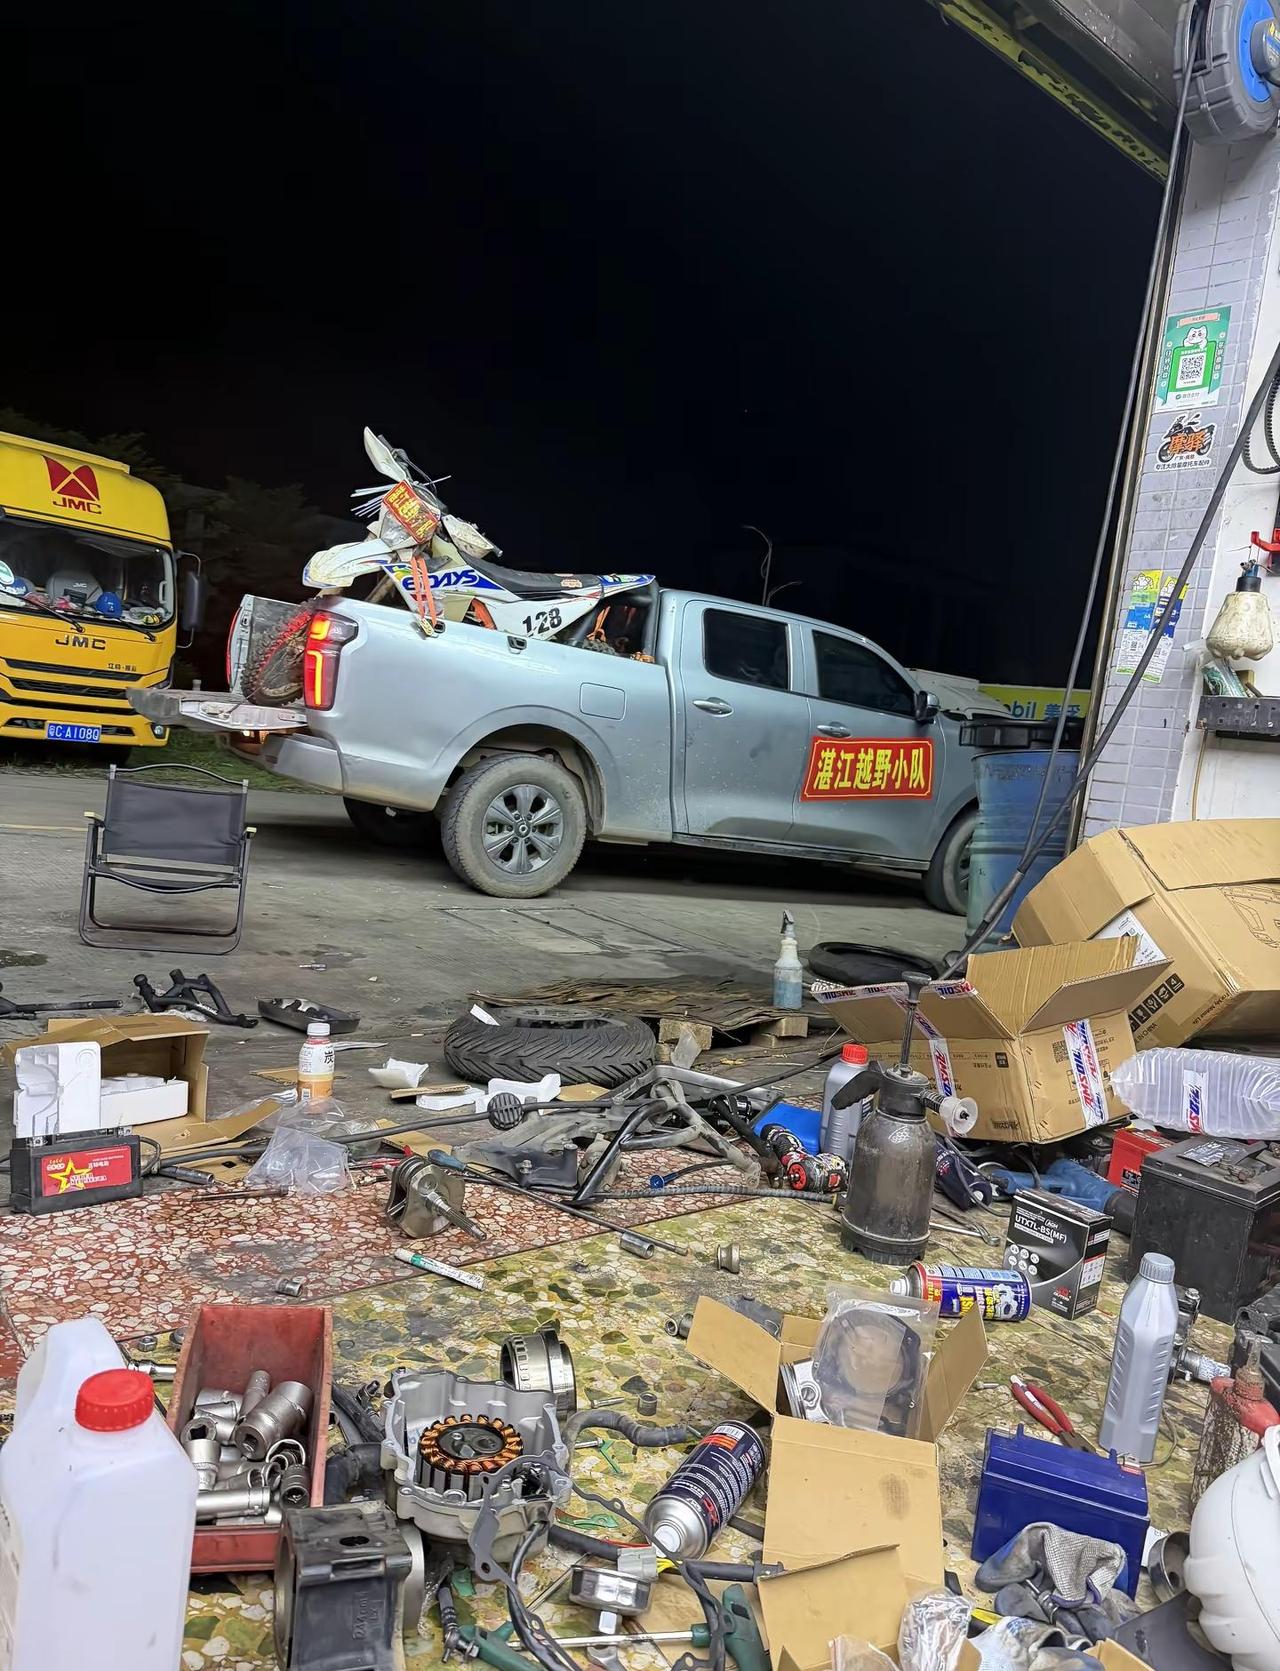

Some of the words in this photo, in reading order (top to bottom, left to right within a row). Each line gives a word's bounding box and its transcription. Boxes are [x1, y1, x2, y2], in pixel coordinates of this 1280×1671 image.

[53, 497, 102, 514] JMC
[522, 607, 562, 634] 128
[55, 634, 106, 650] JMC
[813, 747, 925, 791] 湛江越野小队
[1073, 1049, 1094, 1109] AMSOIL
